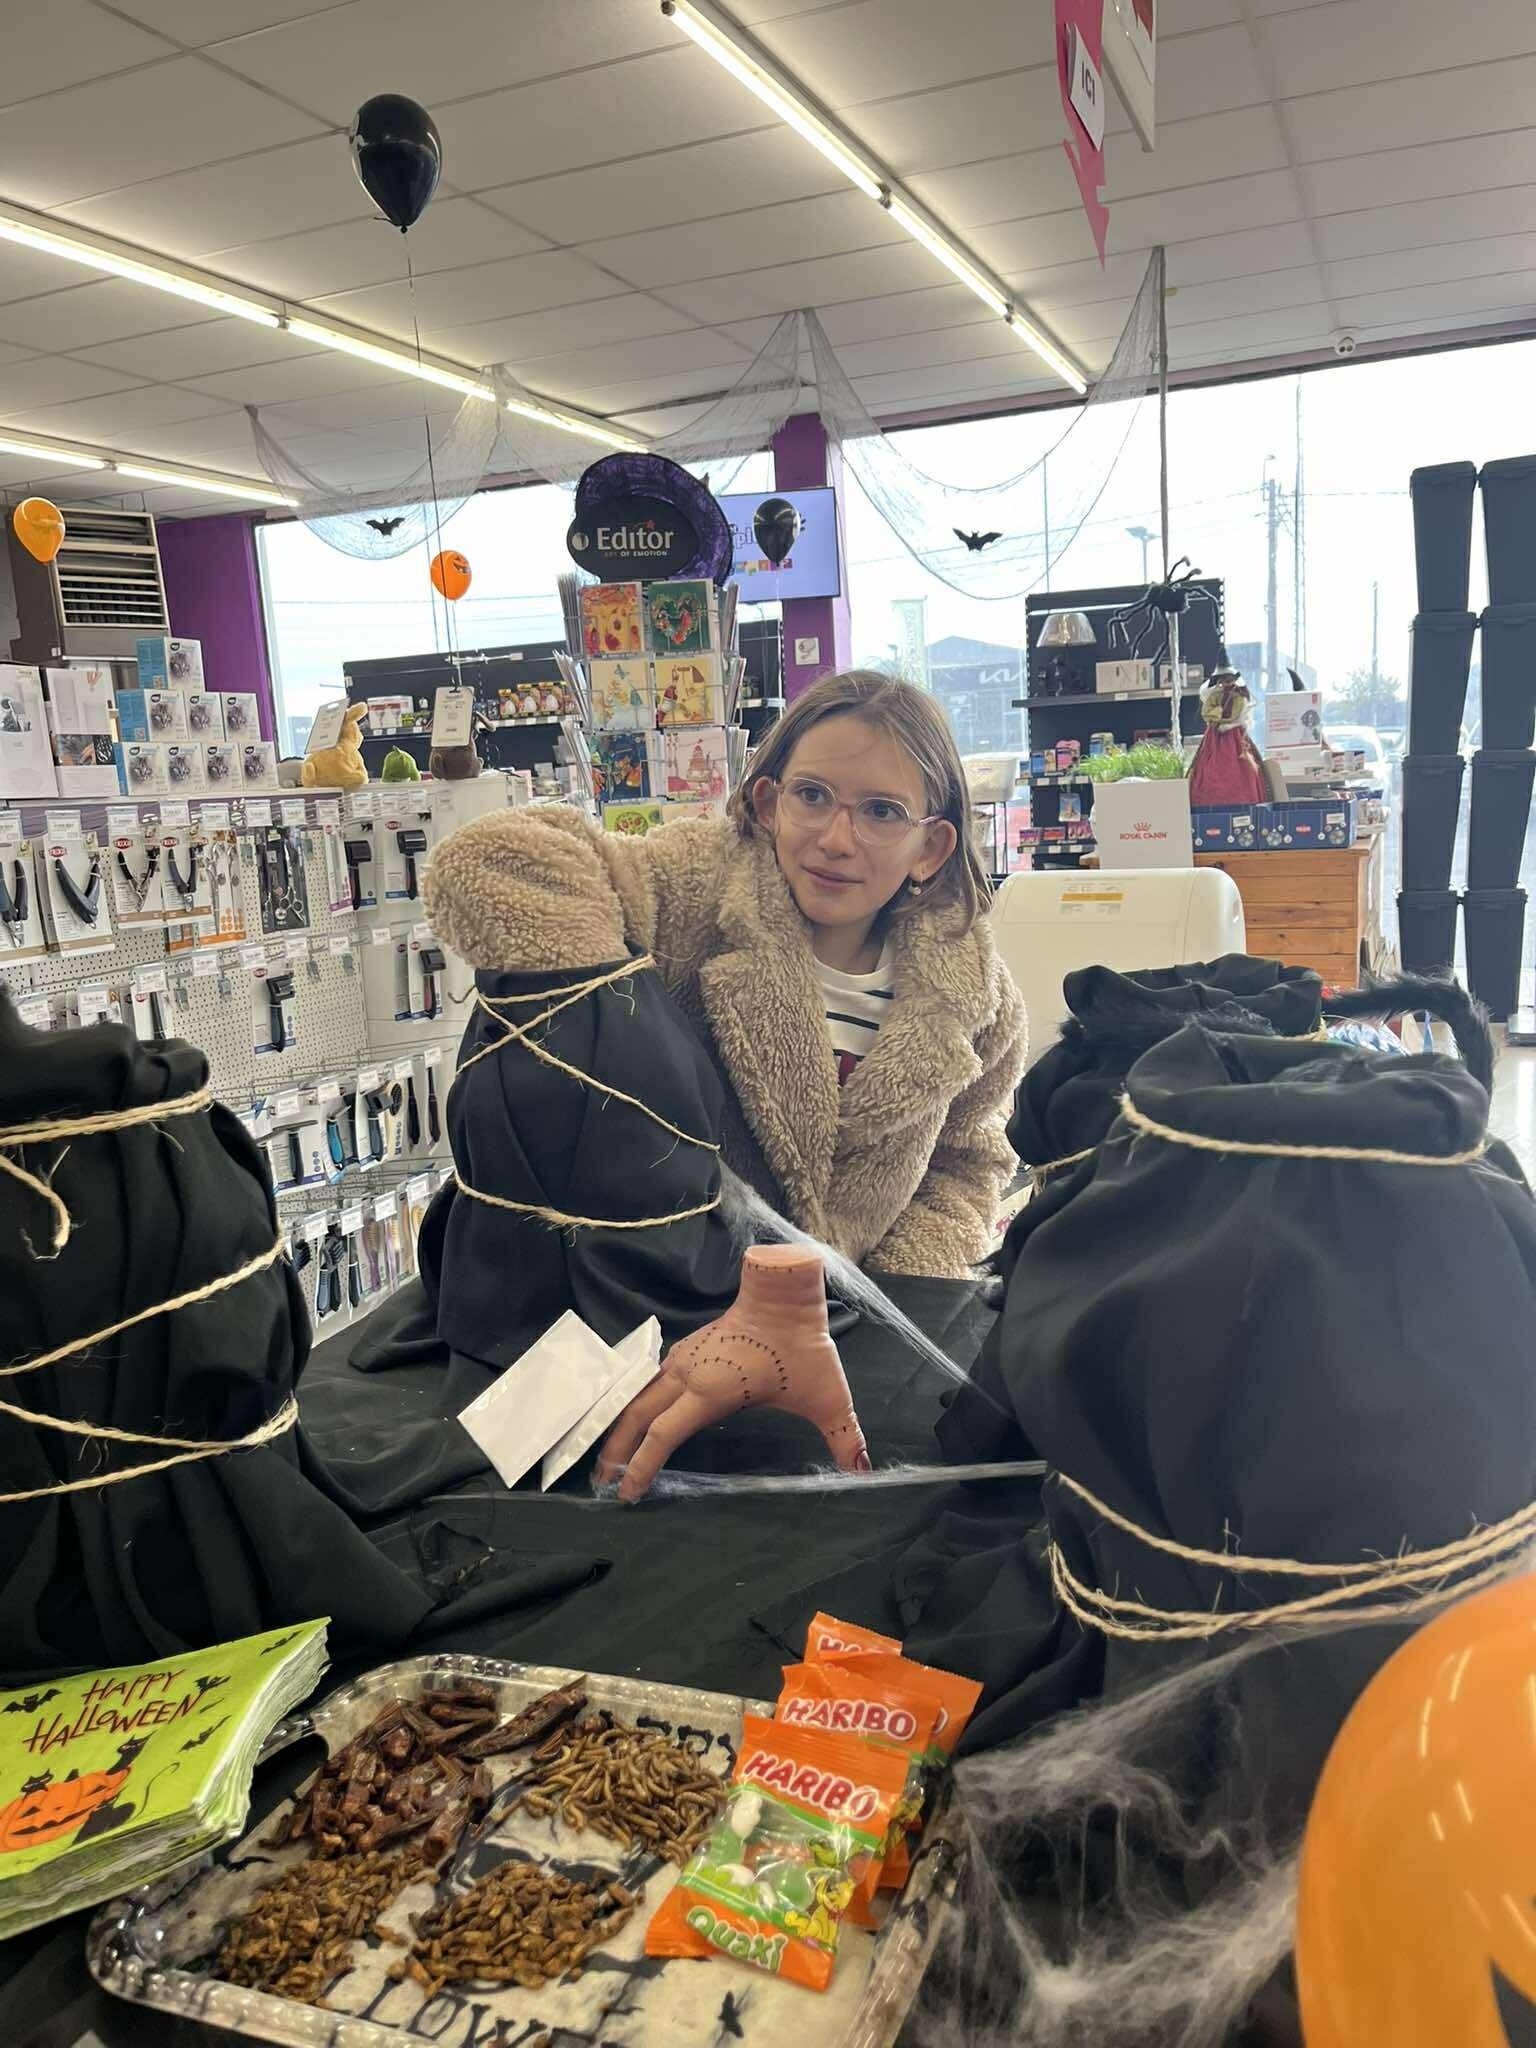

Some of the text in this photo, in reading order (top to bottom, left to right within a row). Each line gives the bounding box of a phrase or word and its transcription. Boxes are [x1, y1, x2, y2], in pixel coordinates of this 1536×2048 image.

[1081, 61, 1096, 105] ICI
[597, 526, 674, 550] Editor
[82, 1669, 187, 1709] HAPPY
[23, 1690, 206, 1756] HALLOWEEN
[782, 1696, 917, 1741] HARIBO
[743, 1752, 880, 1821] HARIBO
